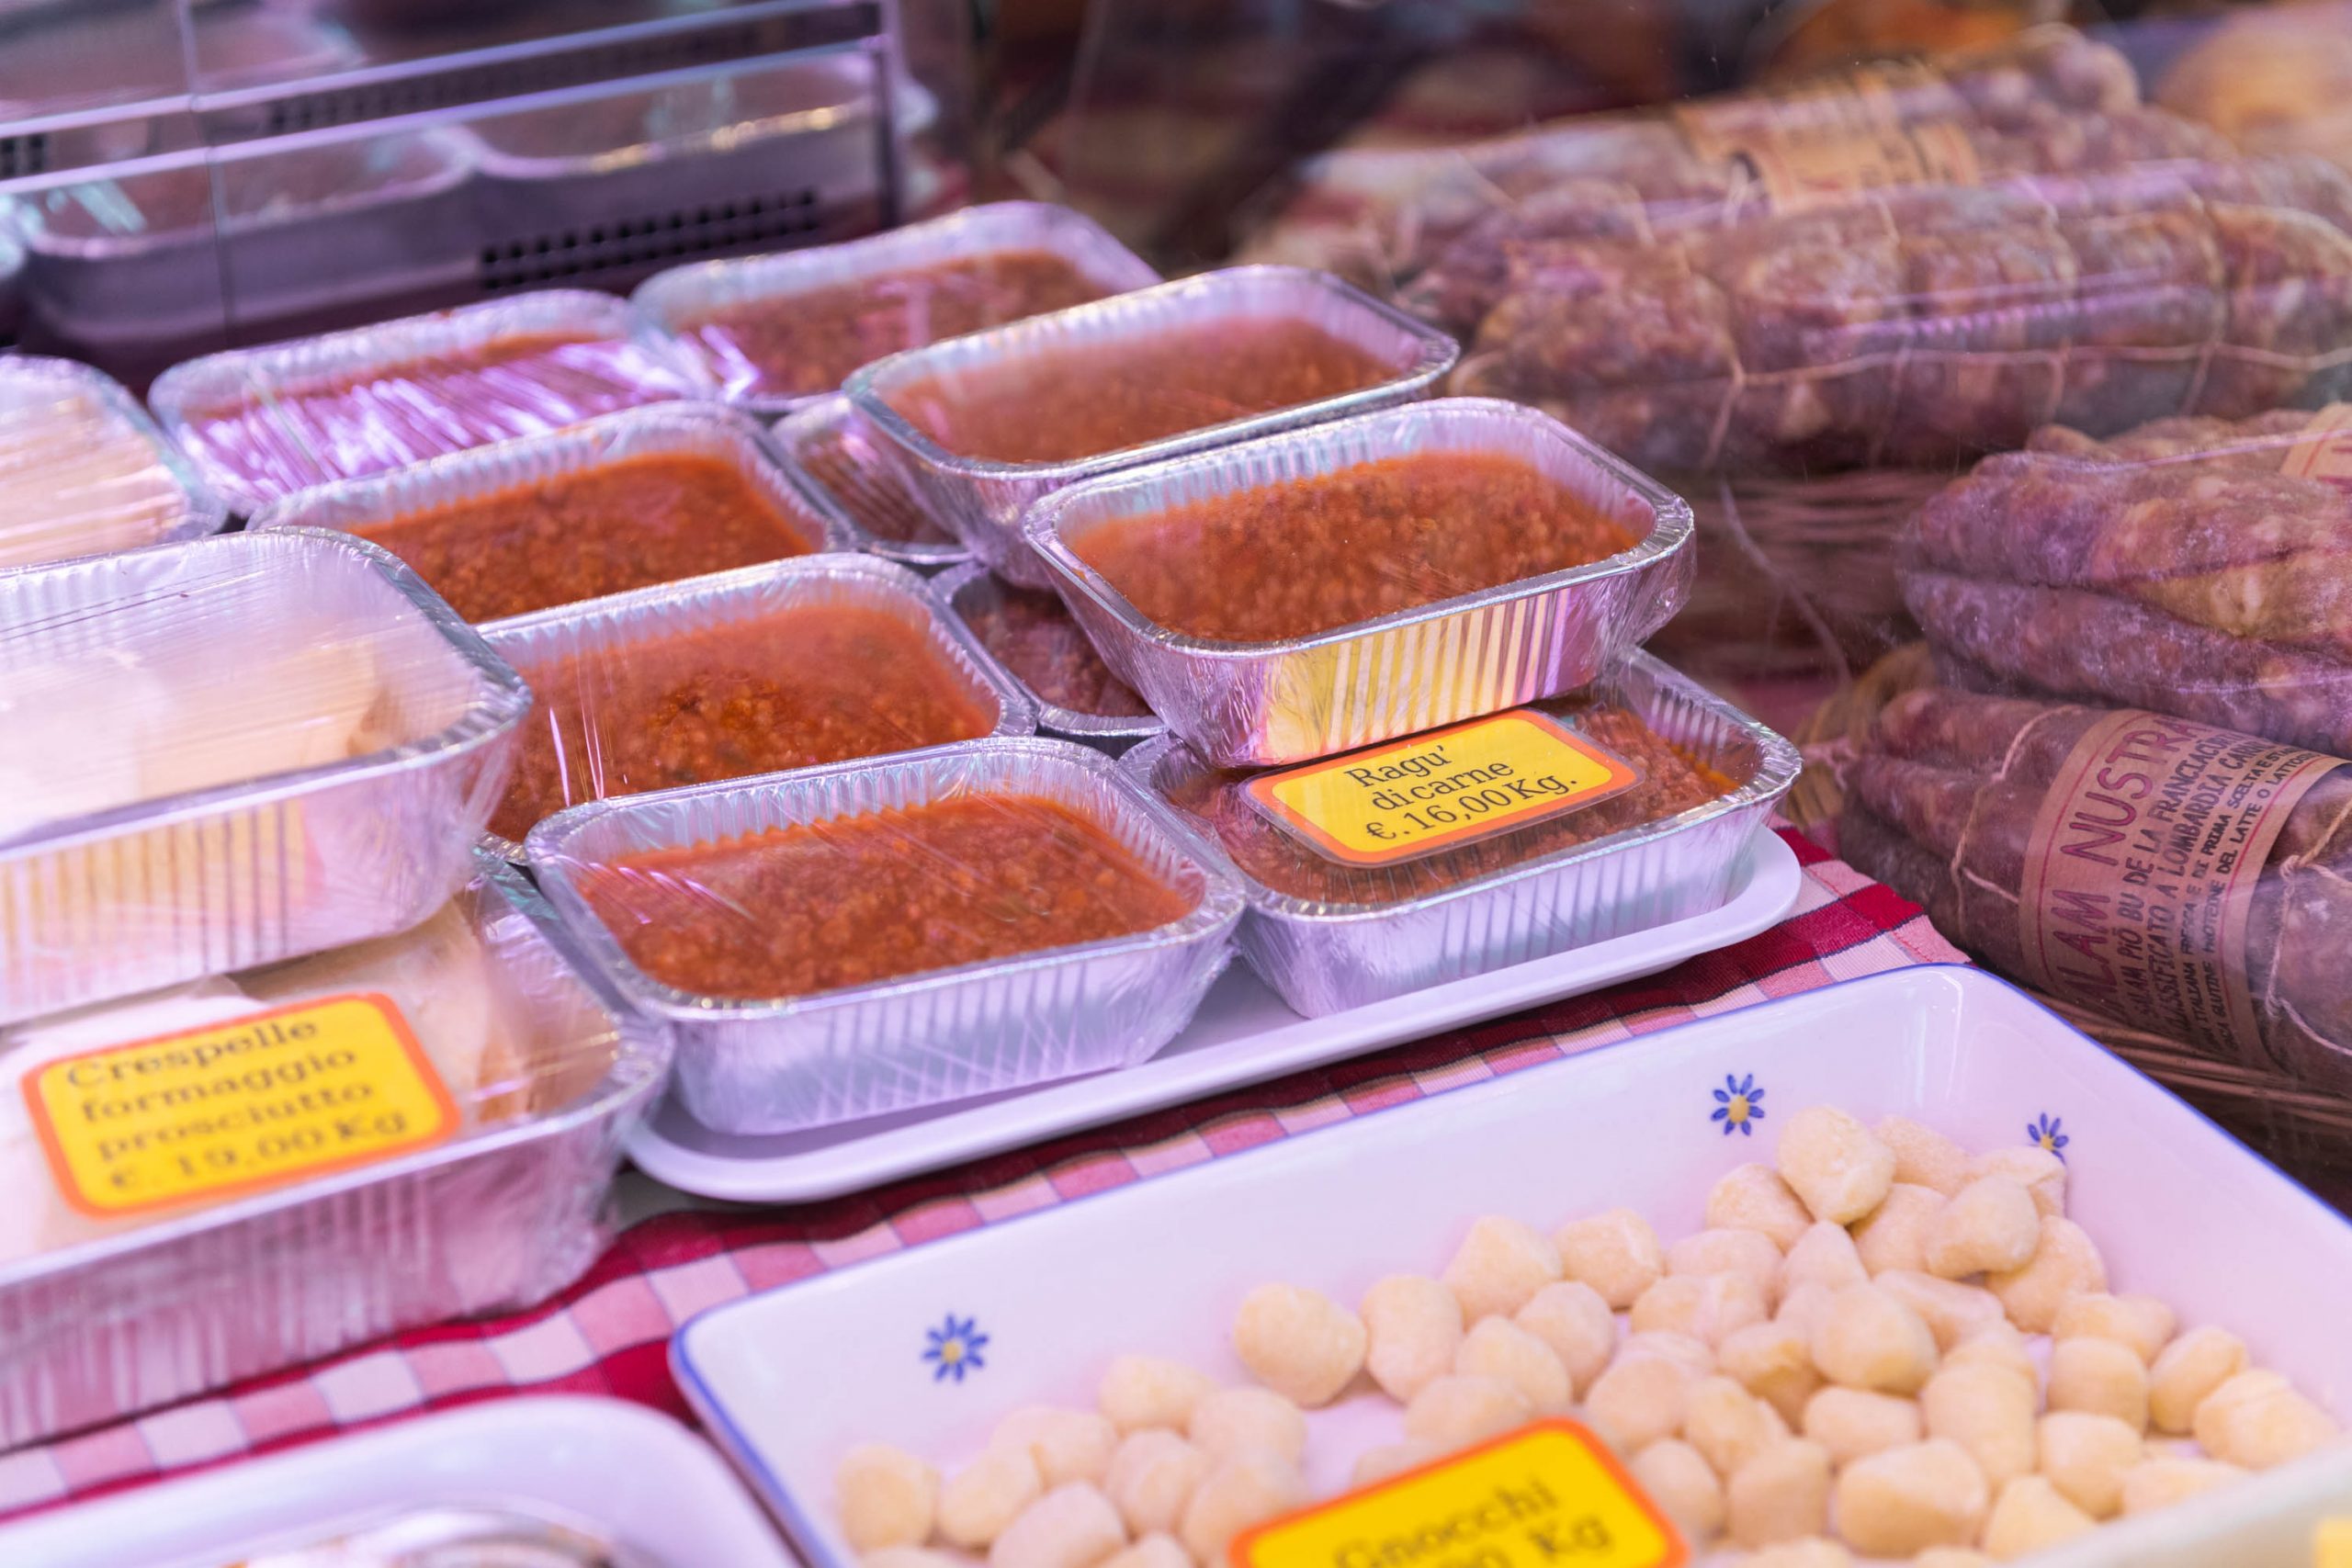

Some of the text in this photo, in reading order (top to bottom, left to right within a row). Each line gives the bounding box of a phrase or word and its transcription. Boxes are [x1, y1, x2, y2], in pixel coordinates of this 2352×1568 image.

[1343, 745, 1453, 787] Ragu'
[1372, 761, 1514, 810] di carne
[1502, 774, 1577, 800] Kg.
[2156, 773, 2233, 877] LOMBARDIA
[2200, 814, 2233, 855] PRIMA
[2226, 769, 2266, 808] SCELTA
[2216, 850, 2238, 874] DEL
[2229, 803, 2262, 843] LATTE
[2256, 788, 2270, 799] O
[2132, 828, 2162, 854] LA
[2122, 857, 2154, 886] DE
[2155, 884, 2178, 899] A
[2117, 892, 2144, 922] BU
[66, 1018, 319, 1089] Crespelle
[81, 1048, 357, 1123] formaggio
[97, 1082, 373, 1162] prosciutto
[334, 1111, 408, 1141] Kg
[1333, 1478, 1558, 1568] Gnocchi
